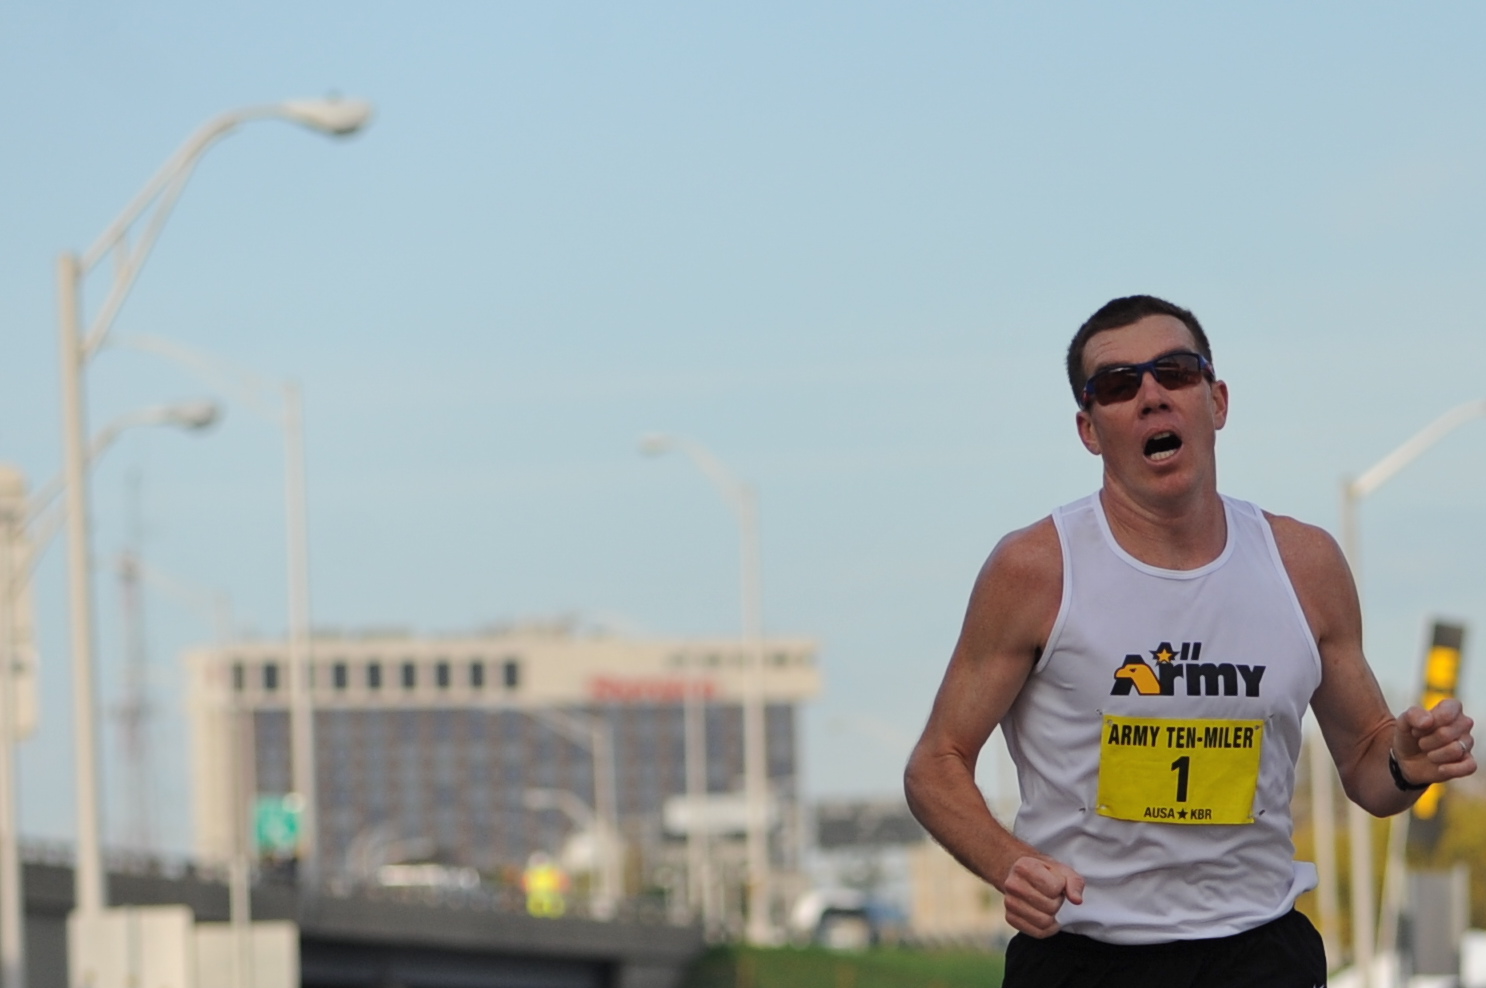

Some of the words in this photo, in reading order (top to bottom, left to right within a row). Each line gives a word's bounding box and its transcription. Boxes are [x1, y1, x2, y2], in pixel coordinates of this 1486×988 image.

[1149, 641, 1202, 664] All
[1110, 654, 1266, 697] Army
[1107, 724, 1160, 747] ARMY
[1166, 726, 1254, 749] TEN-MILER
[1171, 755, 1191, 803] 1
[1143, 806, 1175, 819] AUSA
[1190, 808, 1213, 820] KBR
